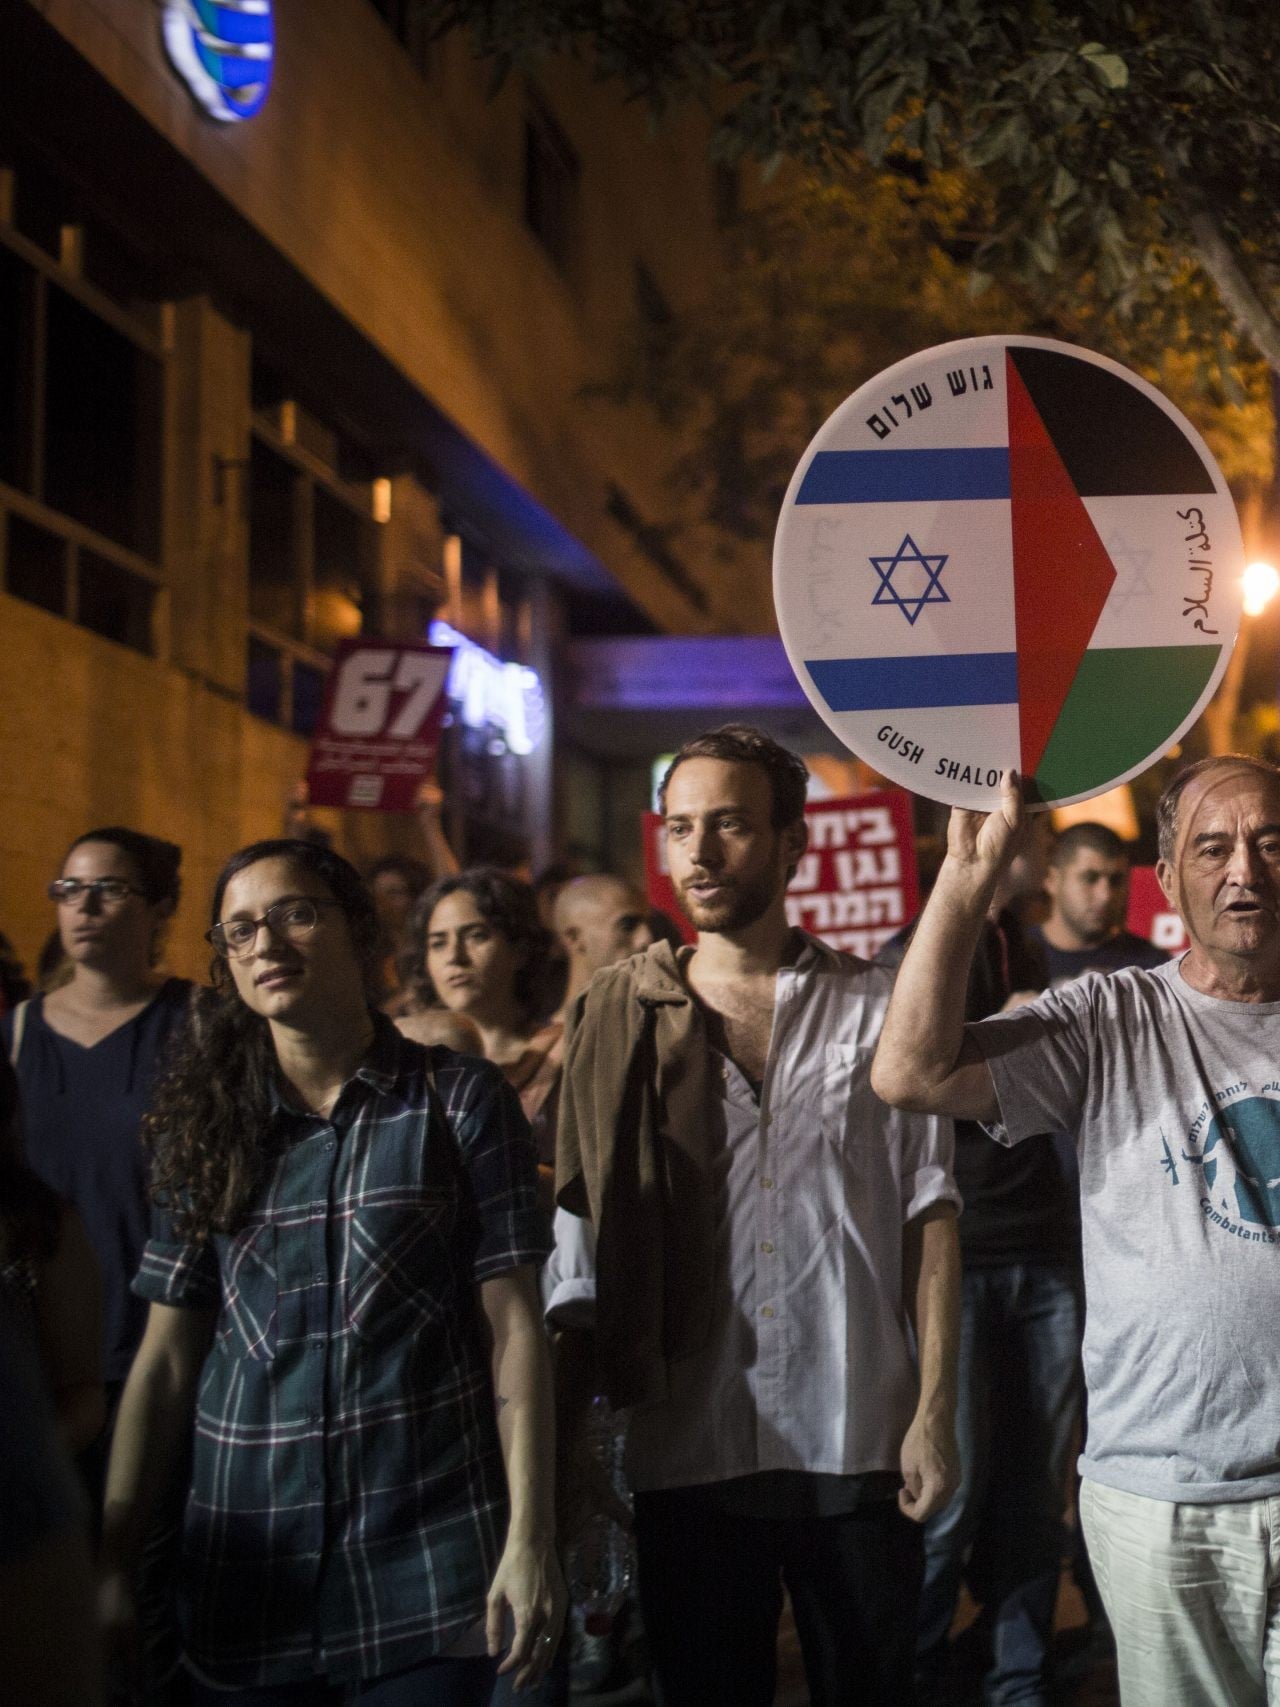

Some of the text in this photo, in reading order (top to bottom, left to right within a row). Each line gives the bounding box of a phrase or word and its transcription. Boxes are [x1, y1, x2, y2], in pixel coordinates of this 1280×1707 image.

[866, 365, 994, 440] גוש שלום
[1176, 507, 1219, 635] كتلة السلام
[330, 649, 451, 738] 67
[877, 725, 1004, 788] GUSH SHALO
[804, 807, 895, 848] ביח
[1188, 1102, 1210, 1144] לשלום
[1200, 1197, 1277, 1243] Combatants
